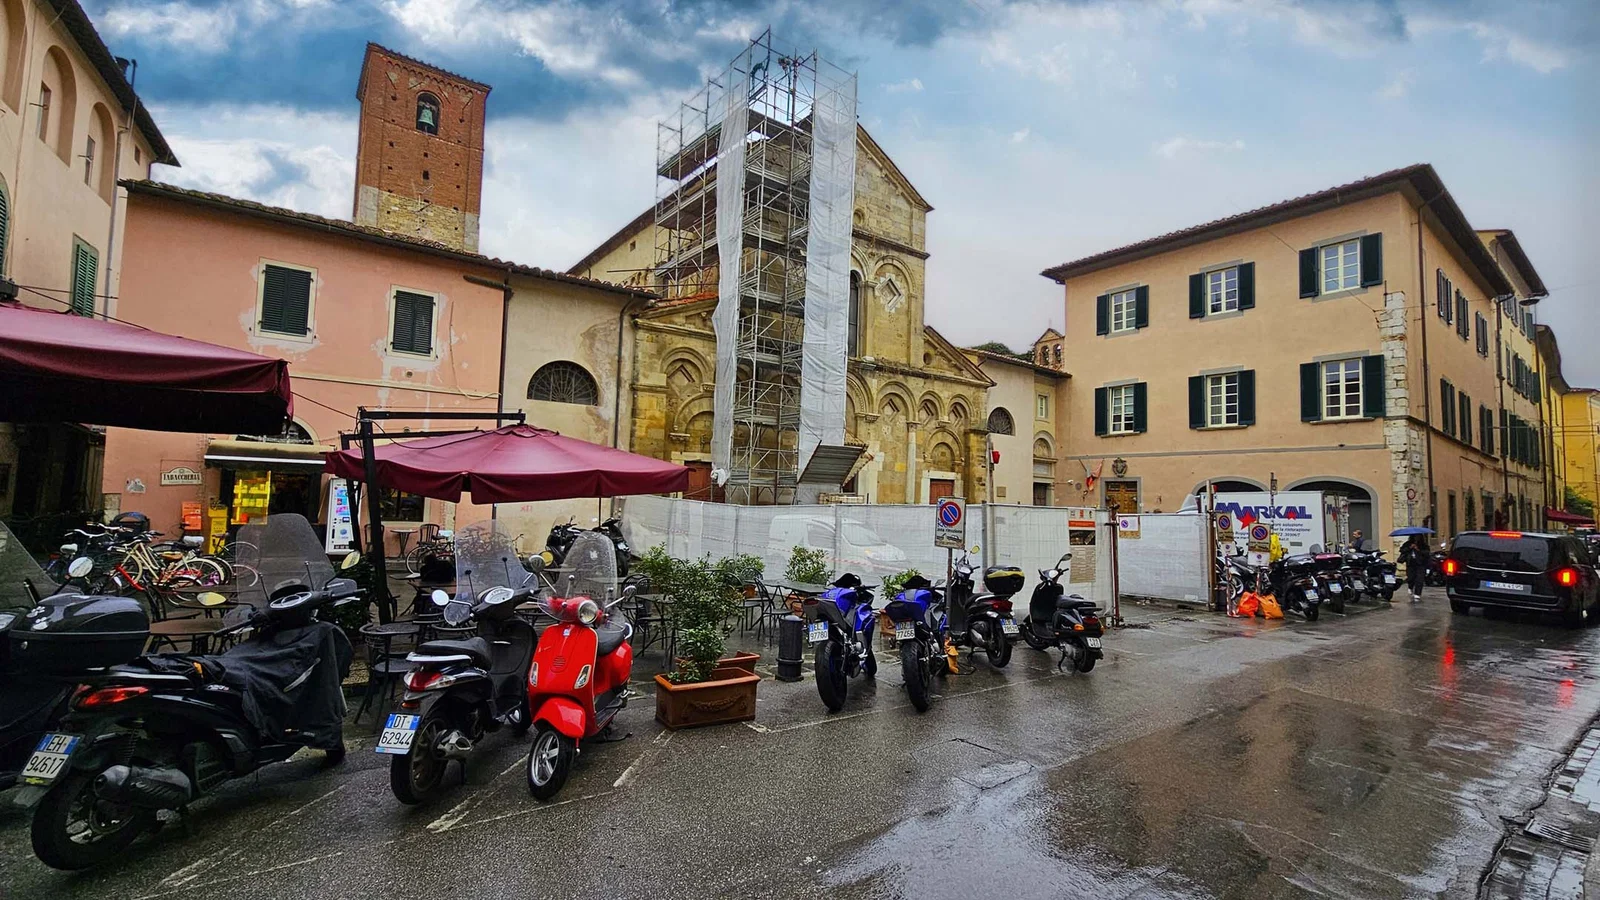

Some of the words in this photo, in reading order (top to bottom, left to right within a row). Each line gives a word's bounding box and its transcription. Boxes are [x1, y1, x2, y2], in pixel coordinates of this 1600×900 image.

[1214, 502, 1312, 519] MARKAL
[393, 716, 408, 728] DT
[46, 735, 66, 751] EH
[381, 732, 413, 745] 62944
[26, 755, 65, 774] 94617
